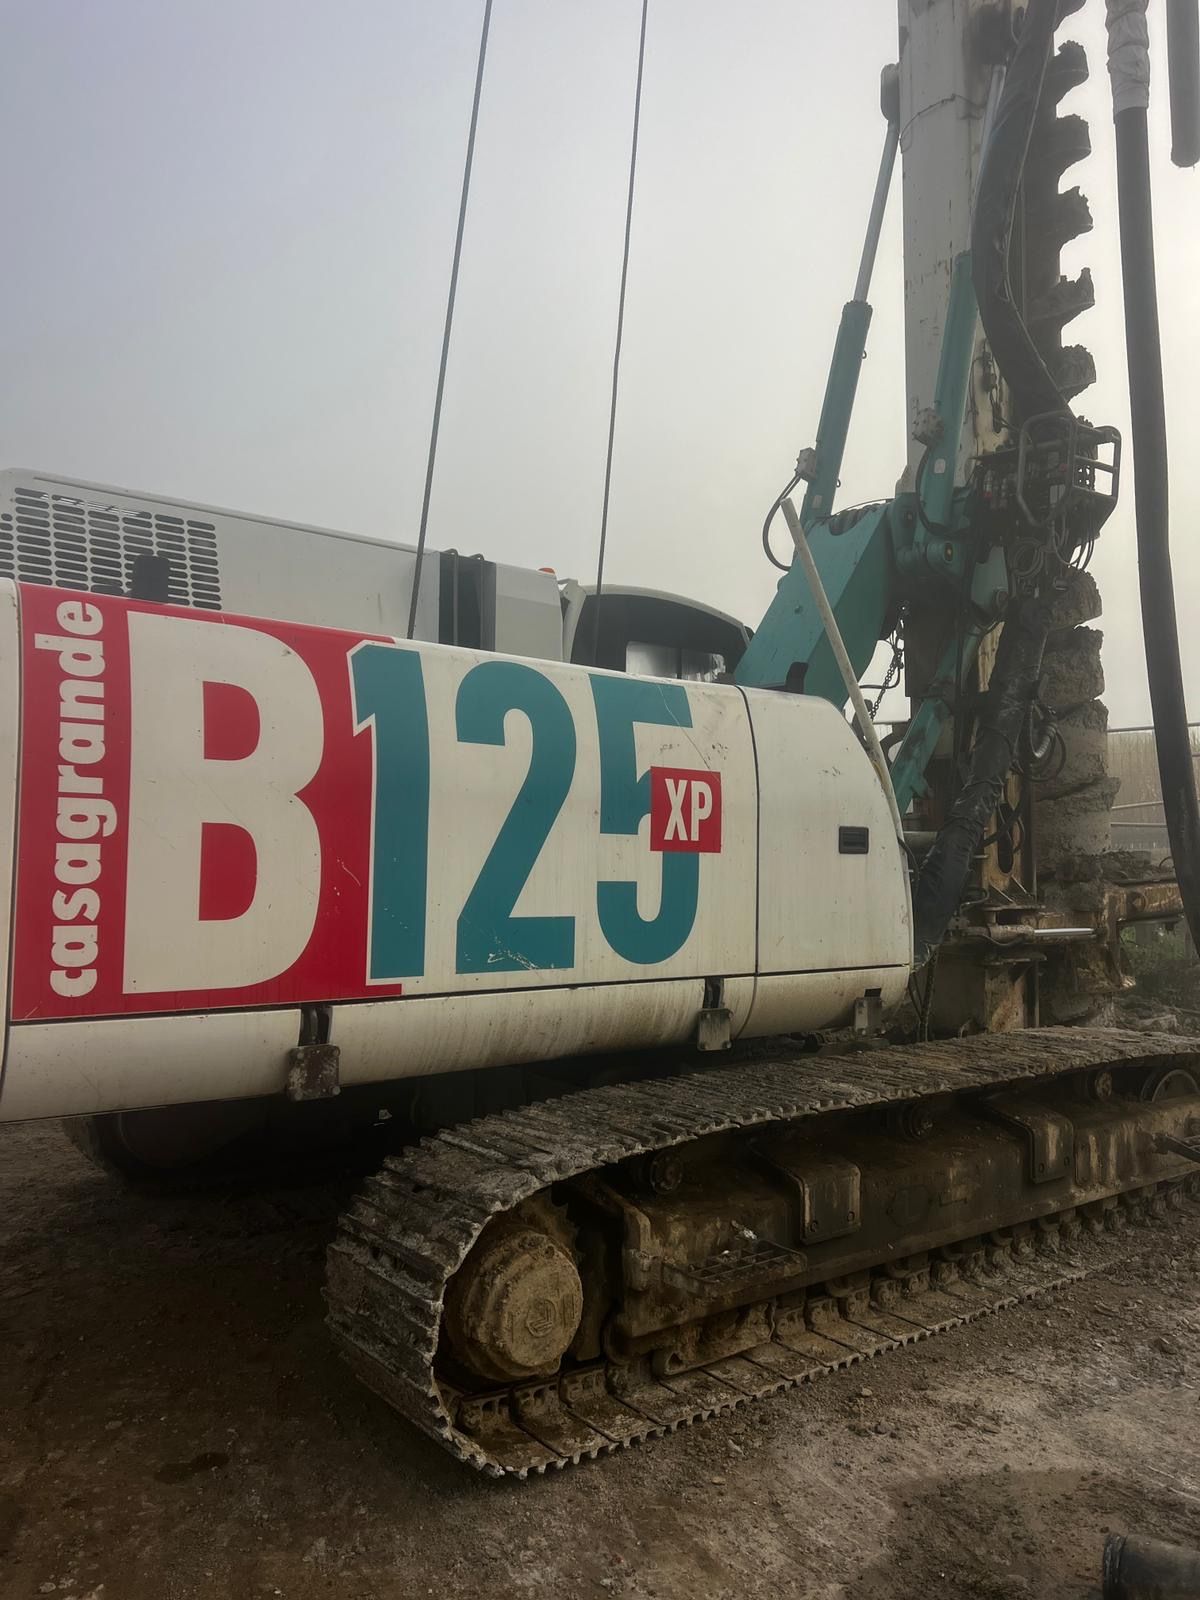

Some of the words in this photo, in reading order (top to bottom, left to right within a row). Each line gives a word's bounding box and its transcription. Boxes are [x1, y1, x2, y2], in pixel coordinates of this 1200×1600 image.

[35, 600, 117, 997] casagrande
[123, 610, 700, 994] B125
[664, 778, 712, 841] XP
